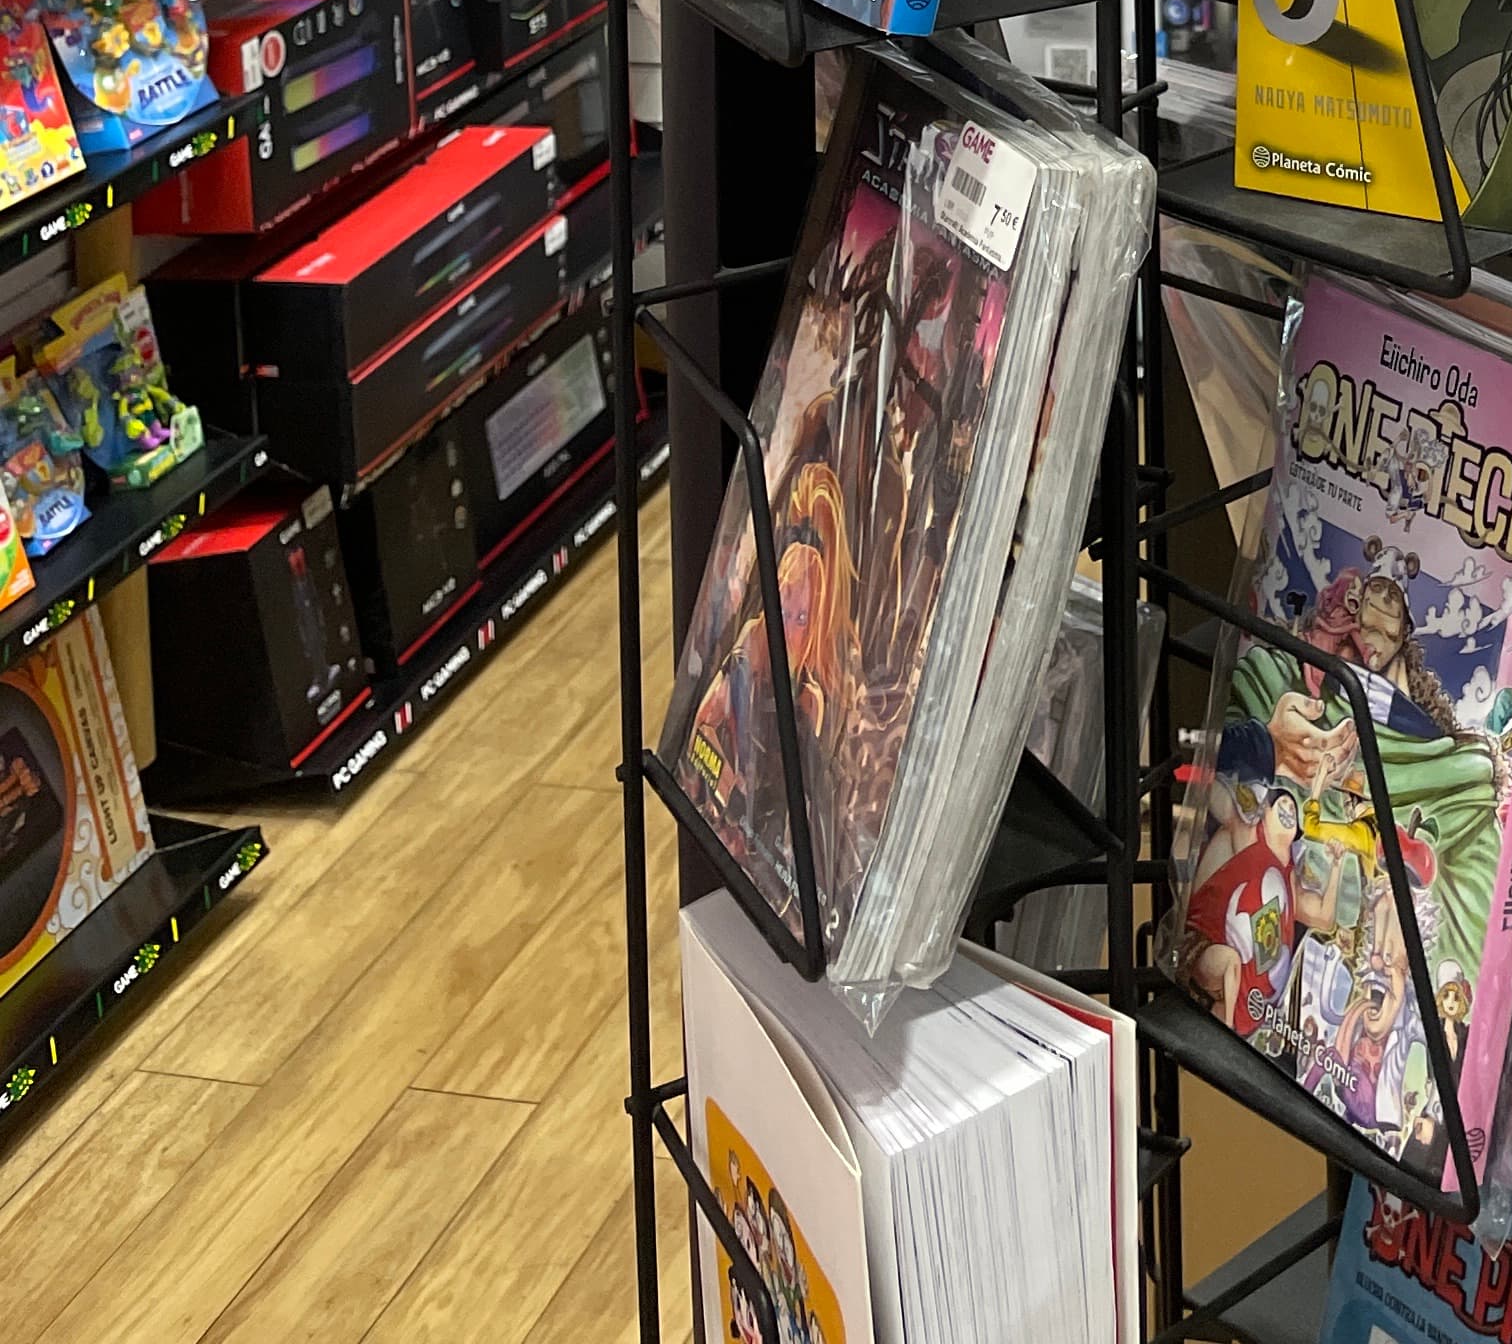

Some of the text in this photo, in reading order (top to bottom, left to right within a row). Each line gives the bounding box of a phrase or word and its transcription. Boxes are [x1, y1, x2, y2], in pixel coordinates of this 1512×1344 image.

[136, 68, 189, 111] BATTLE
[1254, 84, 1413, 130] NAOYA MATSUMOTO
[962, 126, 997, 165] GAME
[1271, 151, 1373, 184] Planeta Cómic
[1380, 334, 1479, 409] Eiichiro Oda
[1295, 360, 1402, 492] ONE
[1265, 1002, 1359, 1094] Planeta Cómic
